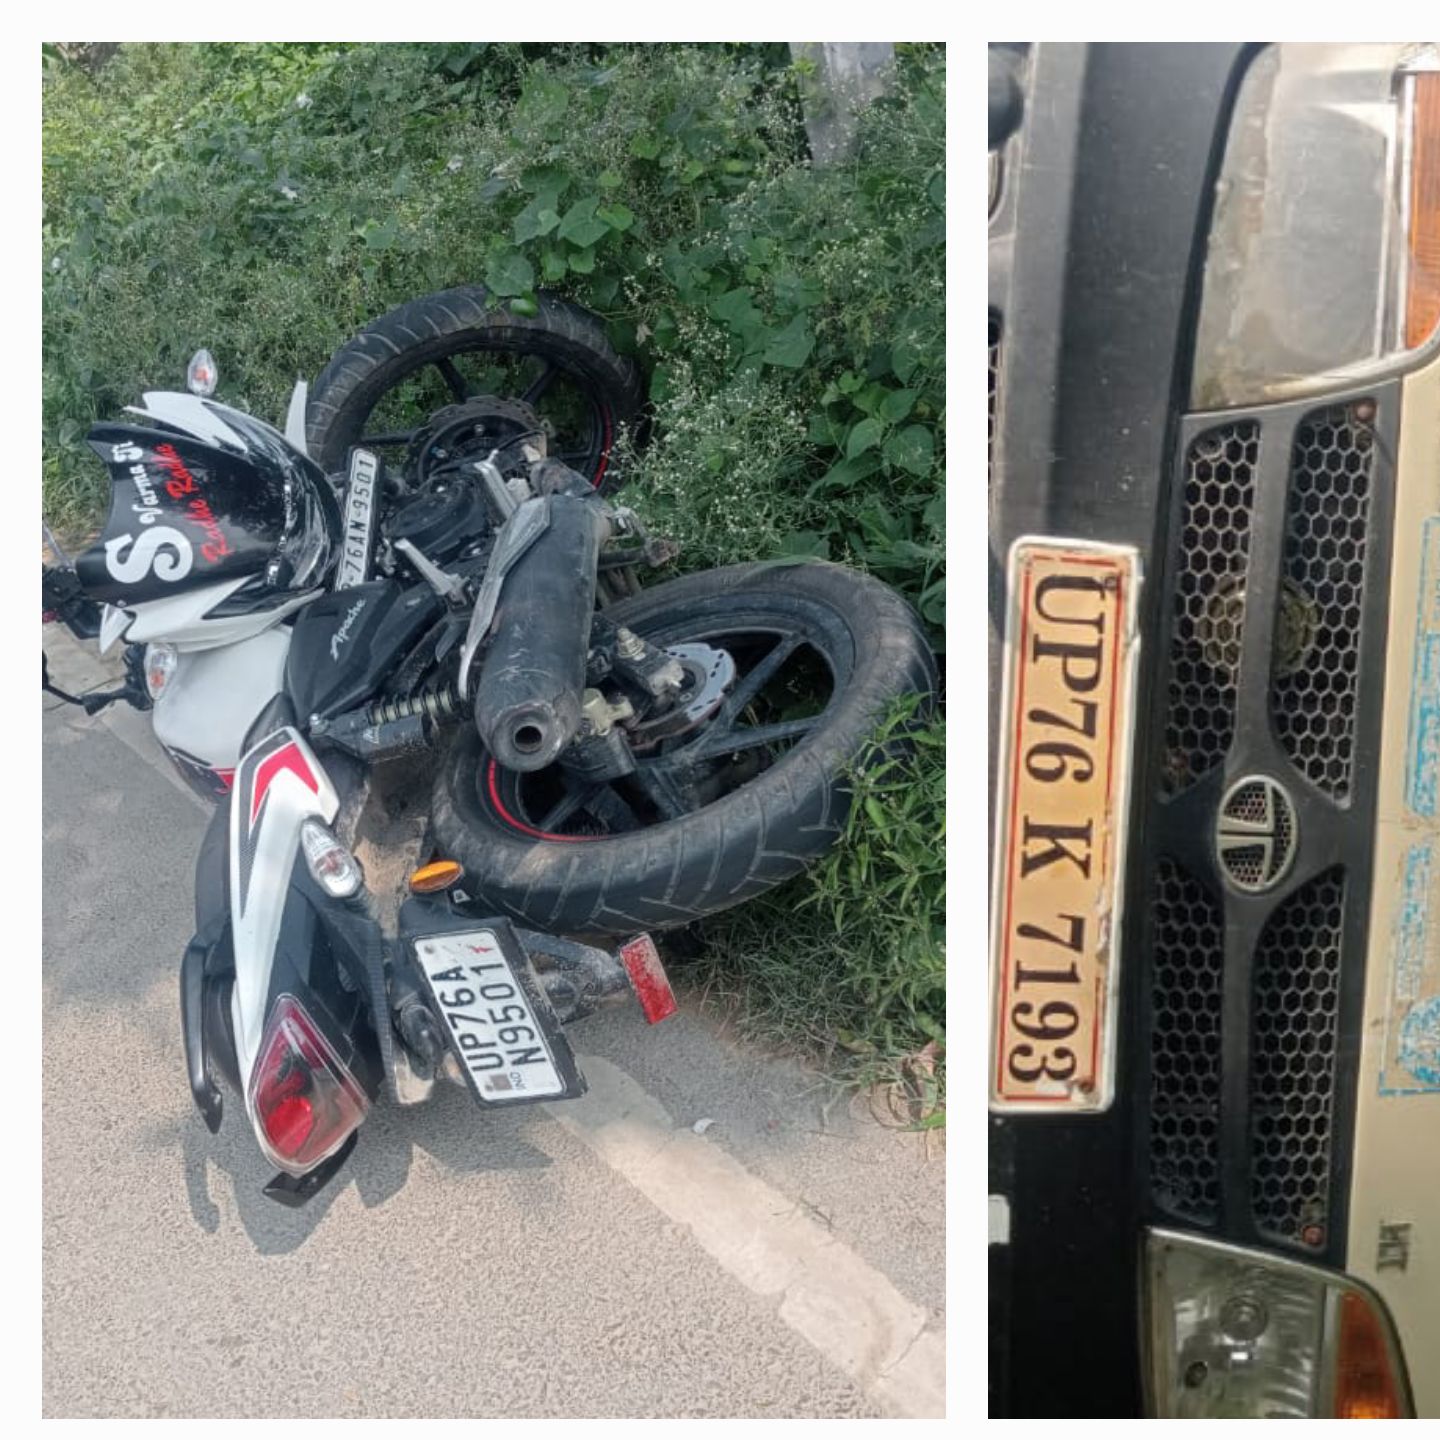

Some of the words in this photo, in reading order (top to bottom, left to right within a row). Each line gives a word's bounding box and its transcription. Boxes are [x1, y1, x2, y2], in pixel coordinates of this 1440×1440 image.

[130, 465, 162, 523] Varma
[152, 444, 196, 499] Radhe
[105, 527, 193, 584] S
[188, 499, 231, 563] Radhe
[329, 600, 365, 661] Apache
[1025, 573, 1106, 783] UP76
[1020, 814, 1093, 880] K
[431, 965, 505, 1072] UP76A
[470, 963, 547, 1067] N9501
[1008, 914, 1085, 1086] 7193
[510, 1071, 526, 1090] IND
